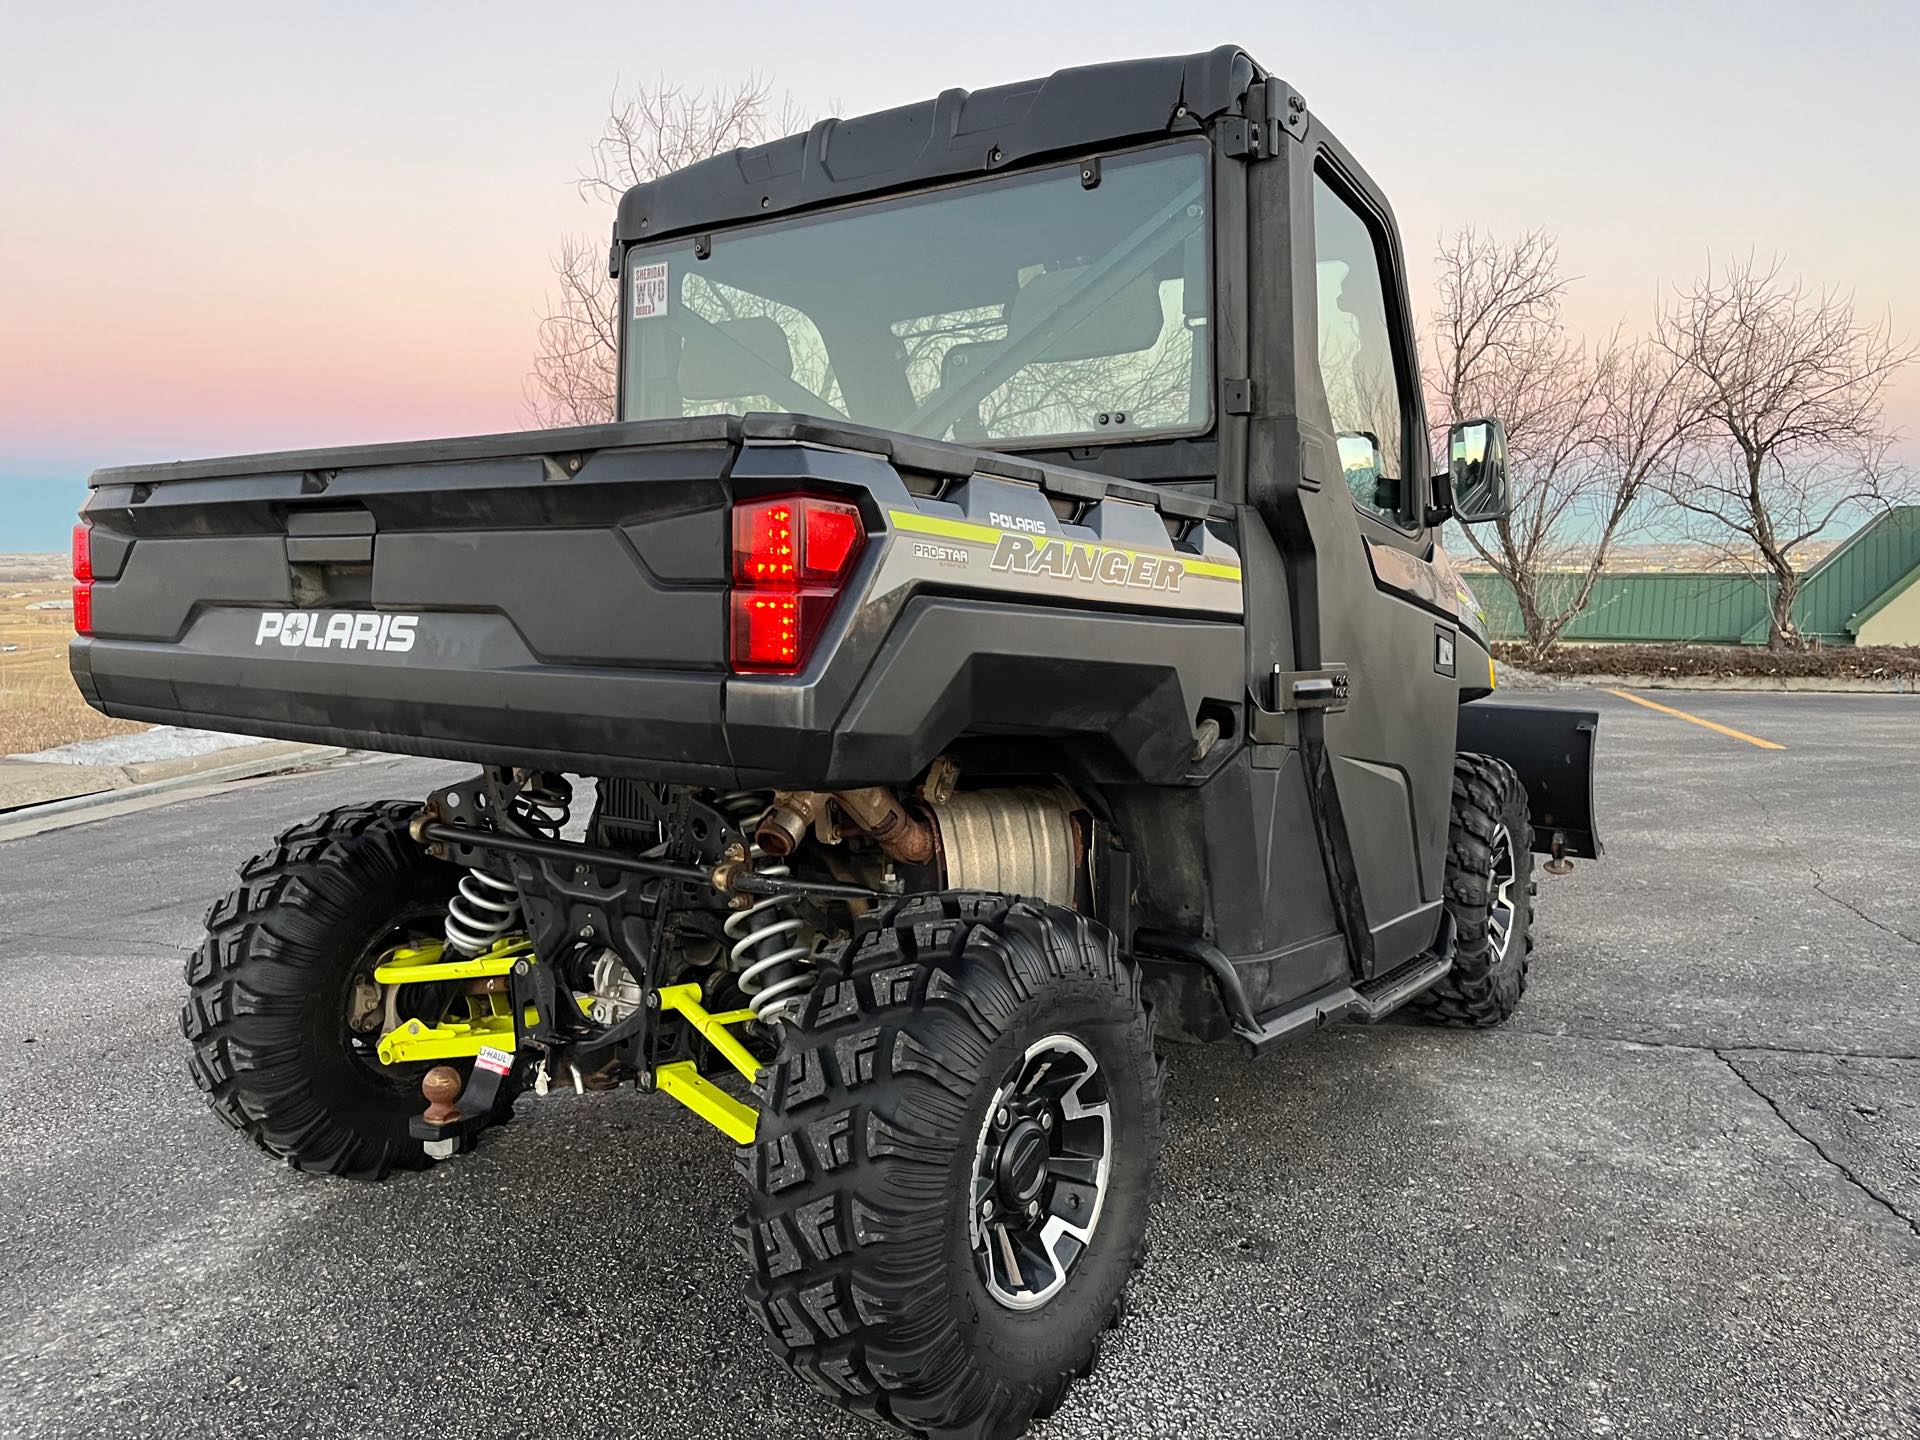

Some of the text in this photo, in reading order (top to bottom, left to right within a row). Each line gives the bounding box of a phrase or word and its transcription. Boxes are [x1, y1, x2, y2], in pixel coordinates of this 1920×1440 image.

[636, 265, 665, 281] SHERIDAN
[989, 511, 1047, 535] POLARIS
[913, 543, 968, 563] PROSTAR
[989, 532, 1185, 592] RANGER
[255, 612, 419, 652] POLARIS
